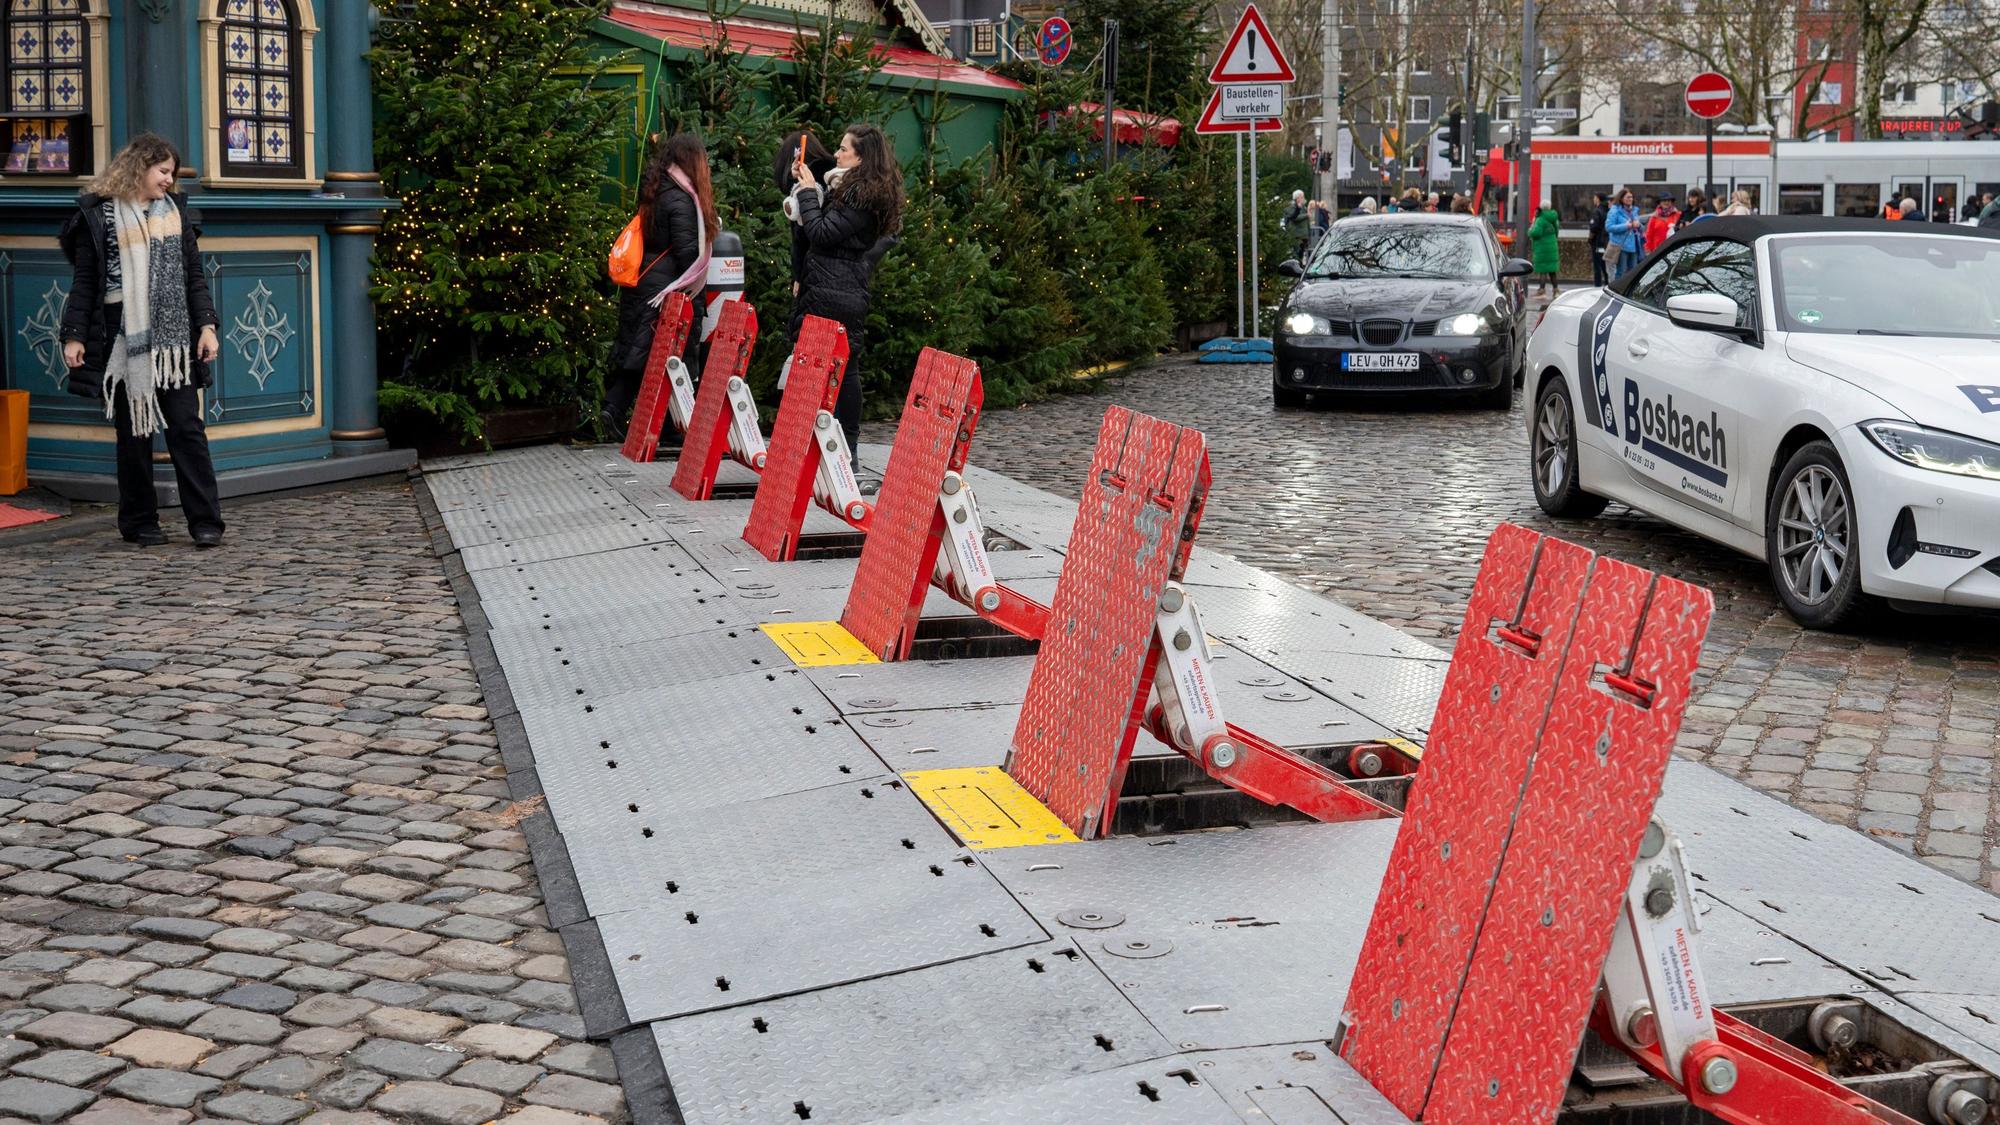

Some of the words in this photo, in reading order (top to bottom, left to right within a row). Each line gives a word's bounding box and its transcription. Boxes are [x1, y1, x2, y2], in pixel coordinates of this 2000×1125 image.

[1226, 88, 1278, 98] Baustellen-
[1236, 102, 1270, 113] verkehr
[1611, 142, 1674, 154] Heumarkt
[1350, 354, 1370, 367] LEV
[1380, 354, 1394, 367] QH
[1396, 354, 1418, 367] 473
[1624, 377, 1726, 470] Bosbach
[1192, 658, 1204, 684] MIETEN
[1202, 692, 1215, 720] KAUFEN
[1675, 928, 1690, 967] MIETEN
[1668, 945, 1688, 1011] zufahrtssperre.de
[1684, 968, 1693, 977] &
[1688, 978, 1704, 1020] KAUFEN
